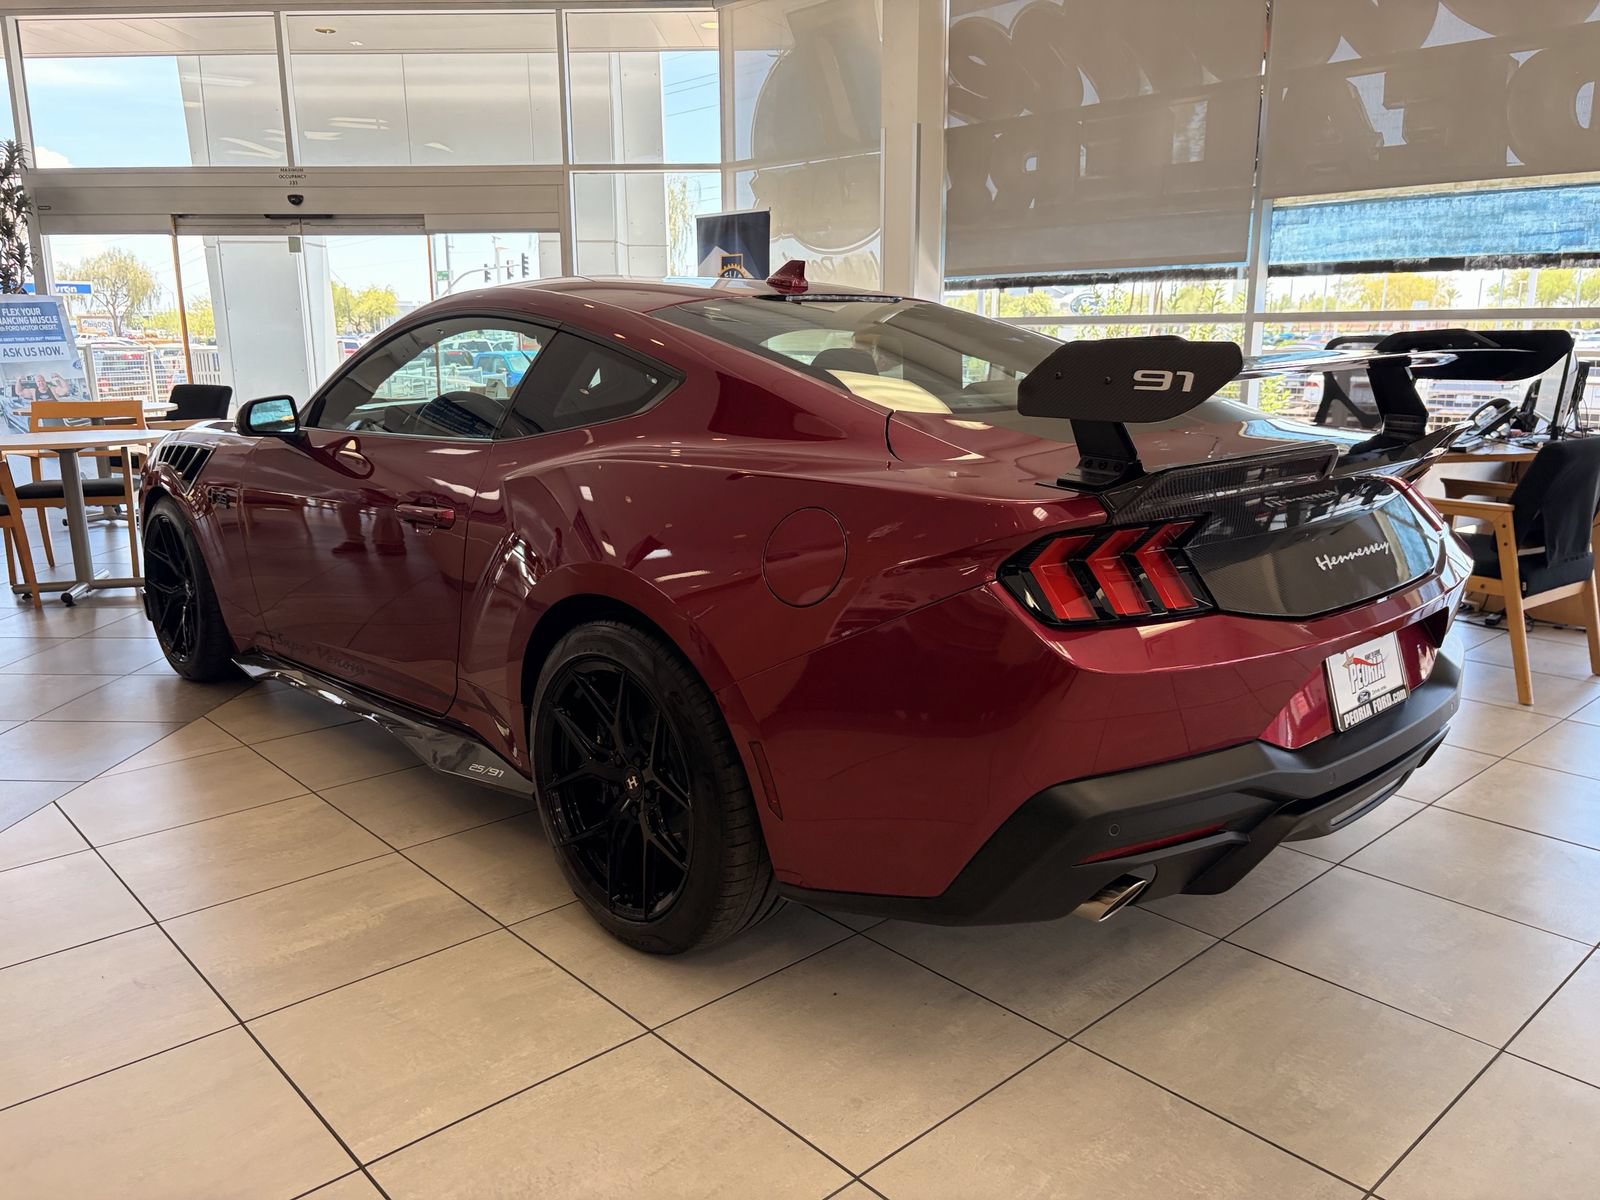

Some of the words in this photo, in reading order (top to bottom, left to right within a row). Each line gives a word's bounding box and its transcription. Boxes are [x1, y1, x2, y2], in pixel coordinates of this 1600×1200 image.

[2, 307, 20, 316] FLEX
[20, 307, 42, 316] YOUR
[30, 315, 59, 324] MUSCLE
[3, 347, 23, 358] ASK
[23, 346, 38, 357] US
[38, 345, 64, 356] HOW.
[1133, 369, 1195, 393] 91
[1315, 541, 1389, 571] Hennessey
[1348, 654, 1387, 694] PEORIA
[1343, 703, 1373, 728] PEORIA
[1373, 689, 1407, 714] FORD.com
[469, 763, 505, 778] 25/91
